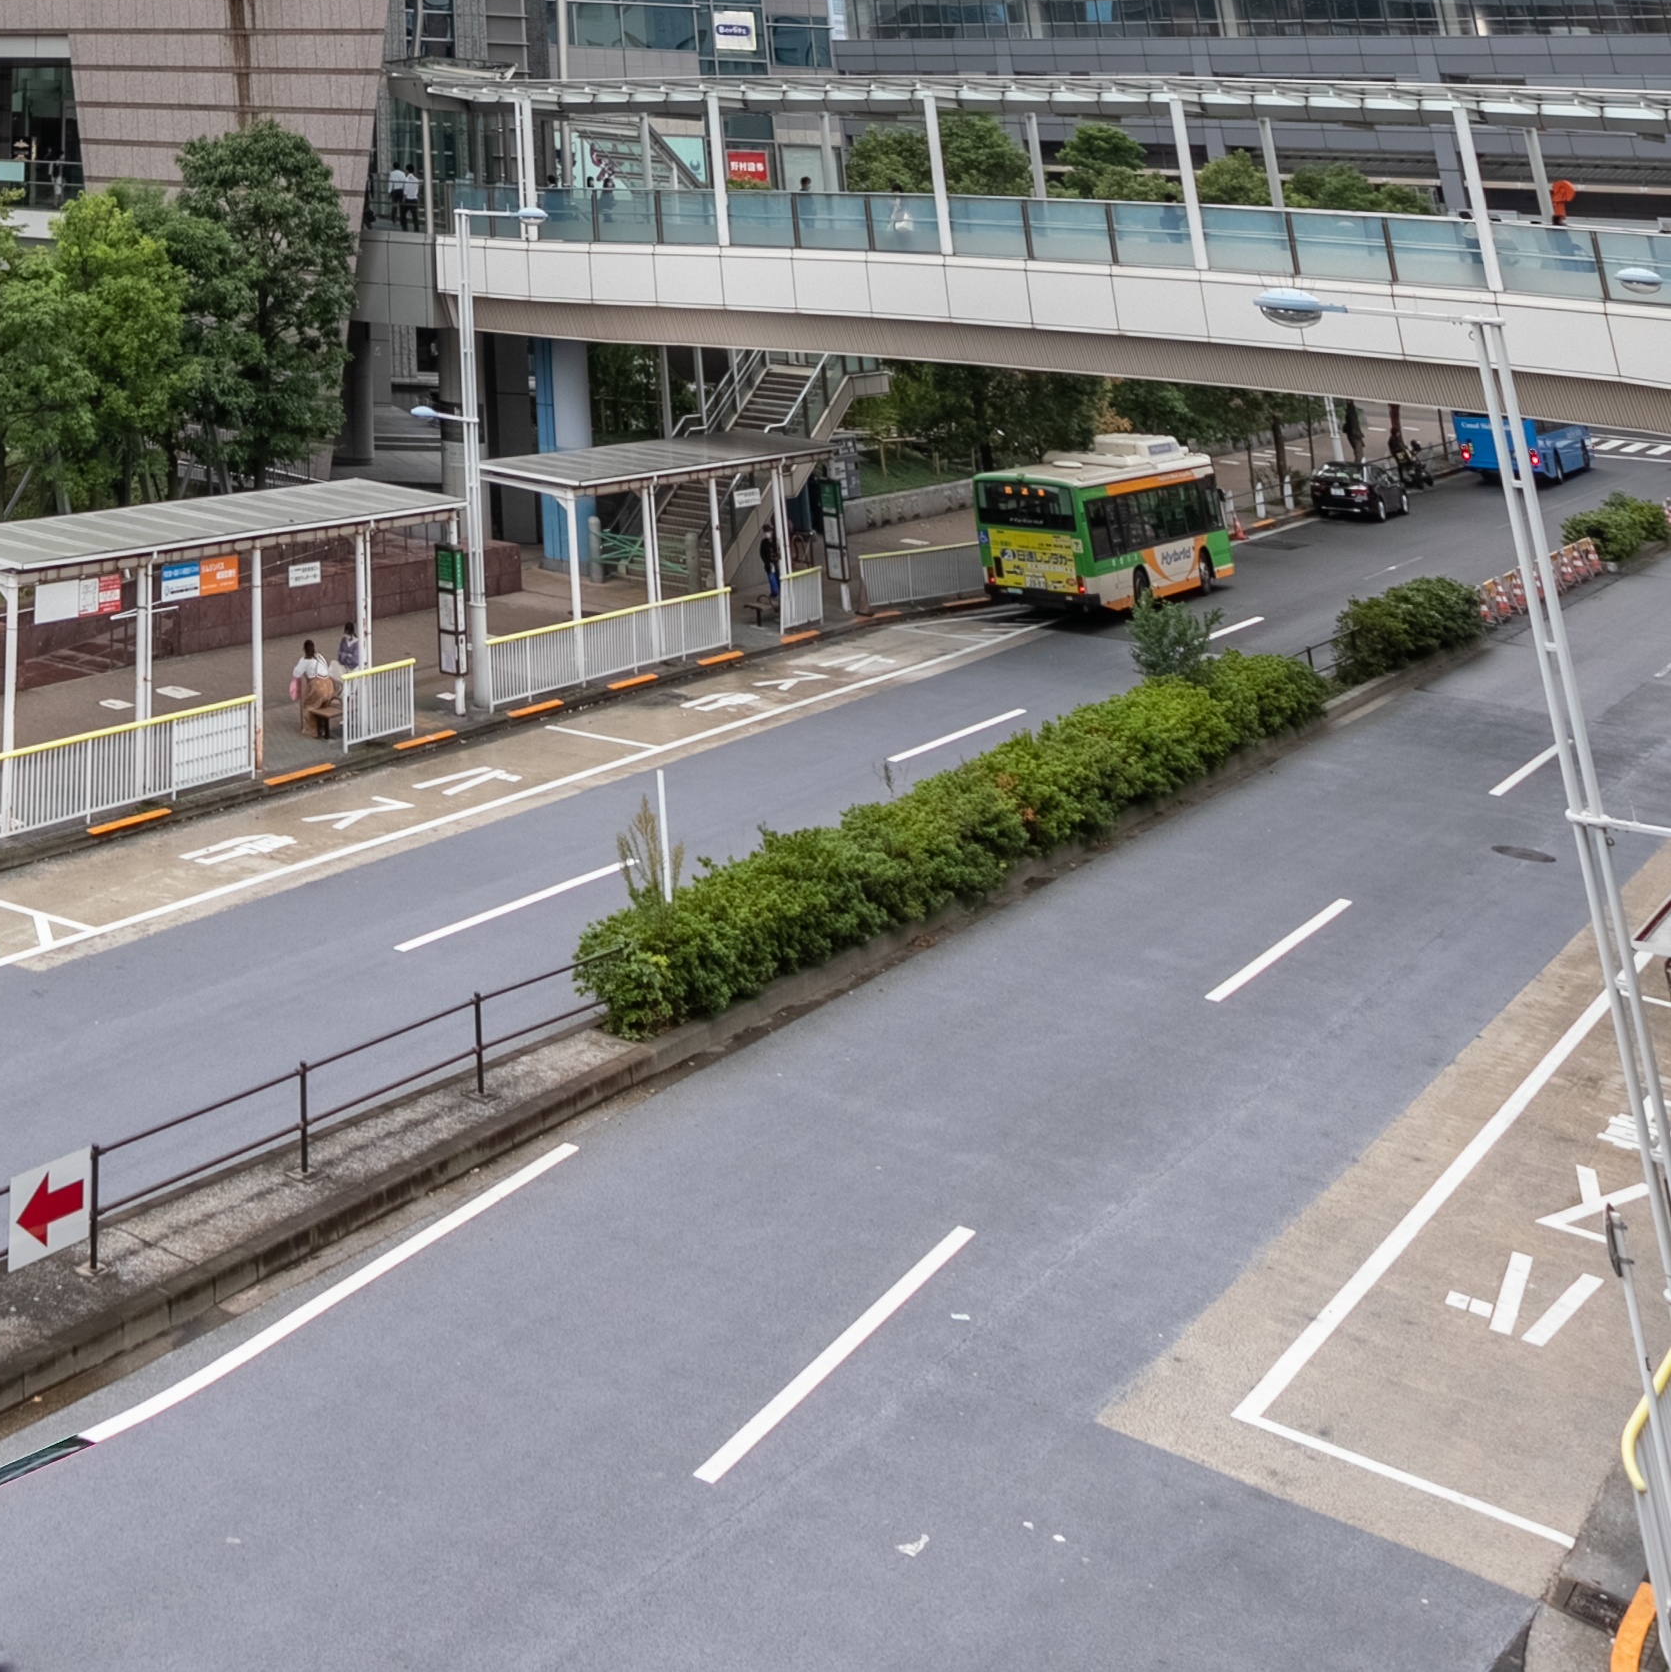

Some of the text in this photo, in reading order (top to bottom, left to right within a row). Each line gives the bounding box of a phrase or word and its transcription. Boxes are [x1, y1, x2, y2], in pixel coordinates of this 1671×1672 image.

[1010, 517, 1044, 525] Hybrid
[1161, 547, 1191, 565] Hybrid
[179, 766, 522, 865] バス停
